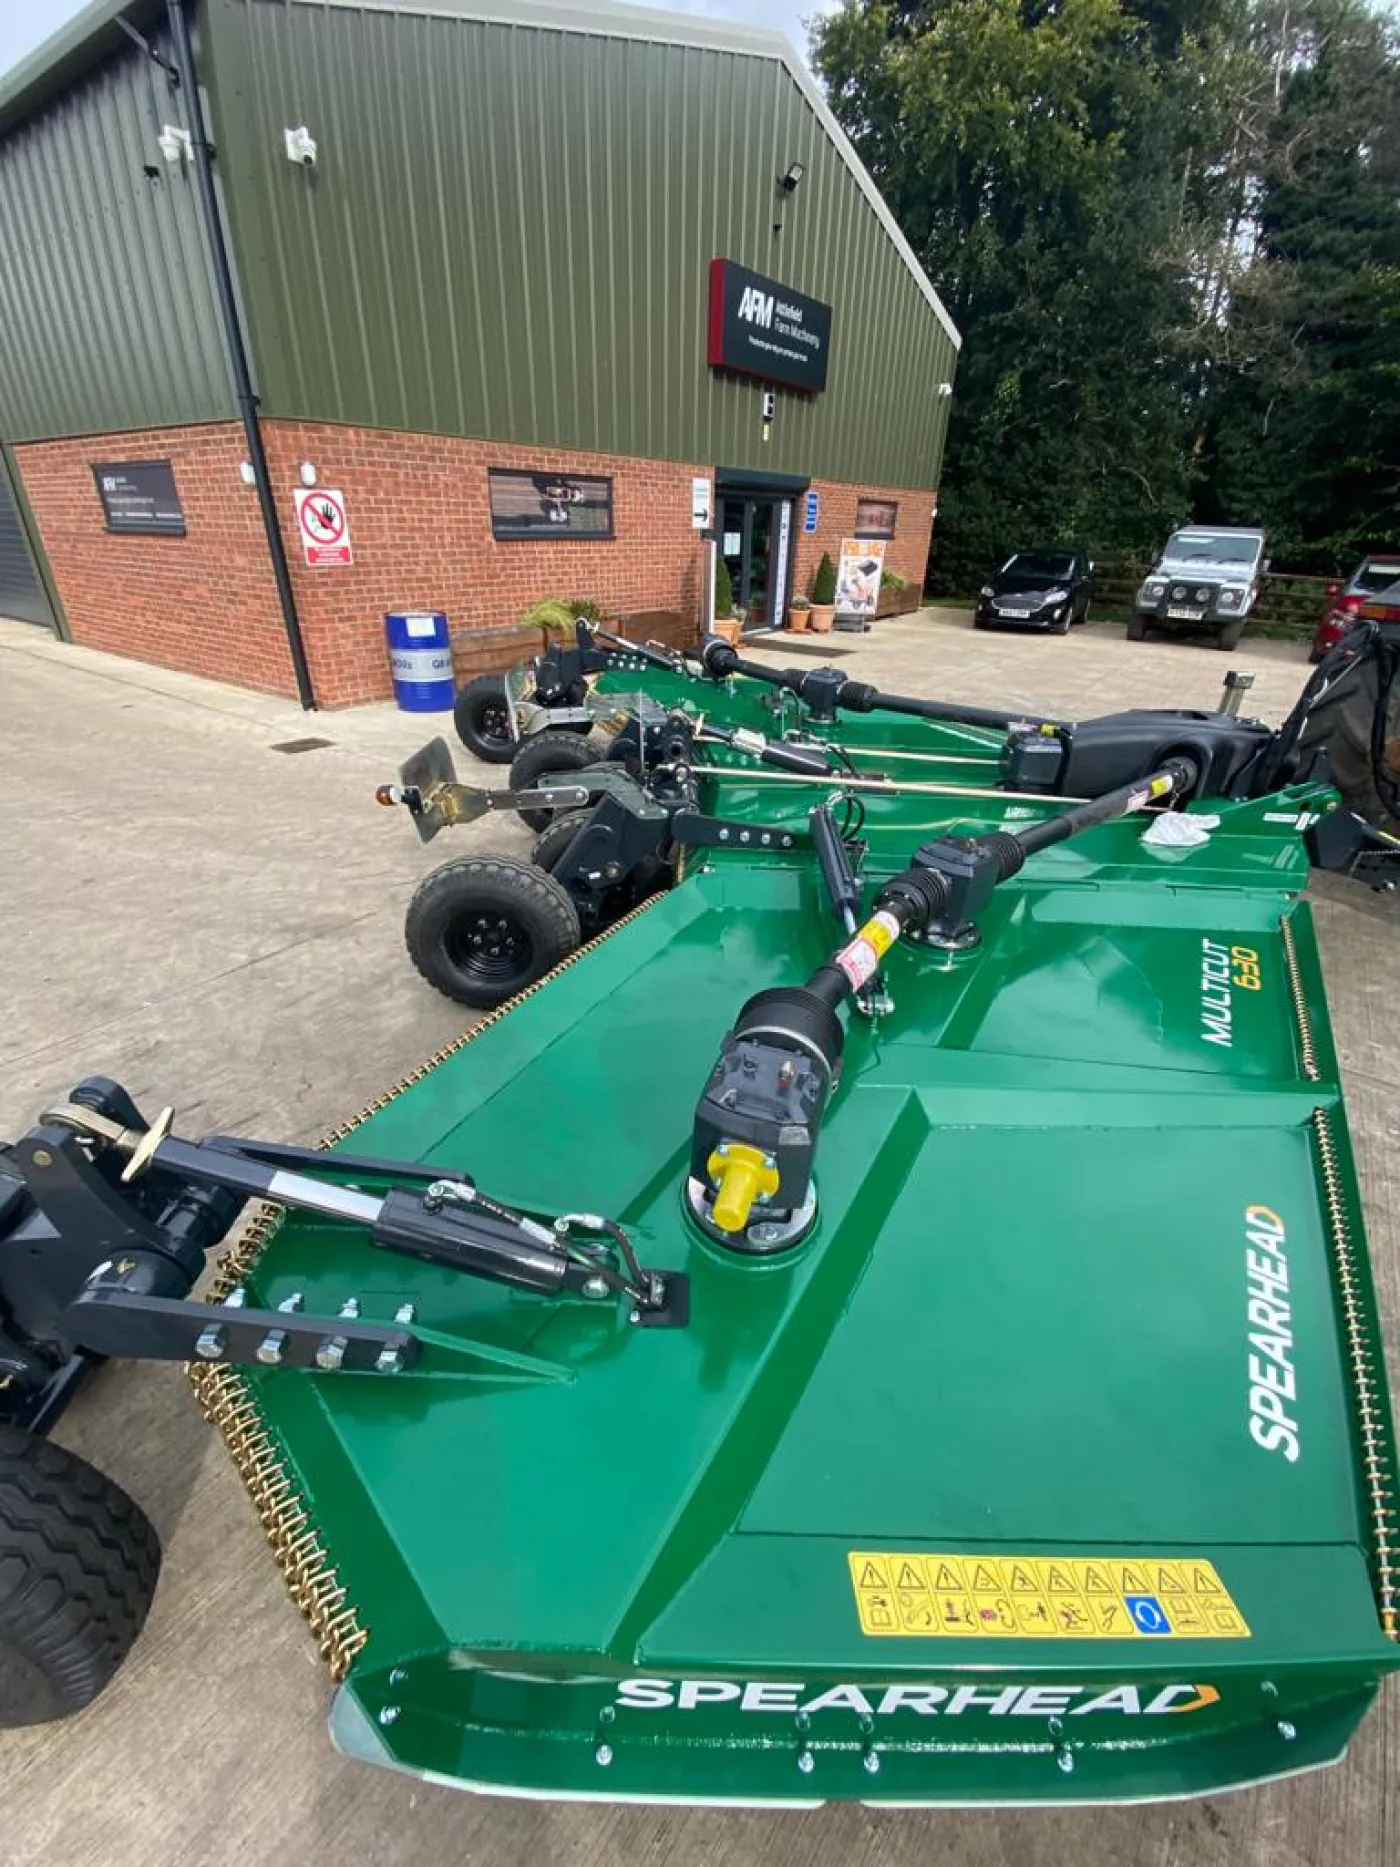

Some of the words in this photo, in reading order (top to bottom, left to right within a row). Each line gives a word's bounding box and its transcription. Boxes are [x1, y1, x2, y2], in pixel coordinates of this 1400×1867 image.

[738, 286, 774, 328] AFM
[1231, 945, 1262, 991] 630
[1201, 938, 1233, 1048] MULTICUT
[1245, 1202, 1300, 1464] SPEARHEAD
[615, 1678, 1222, 1715] SPEARHEAD
